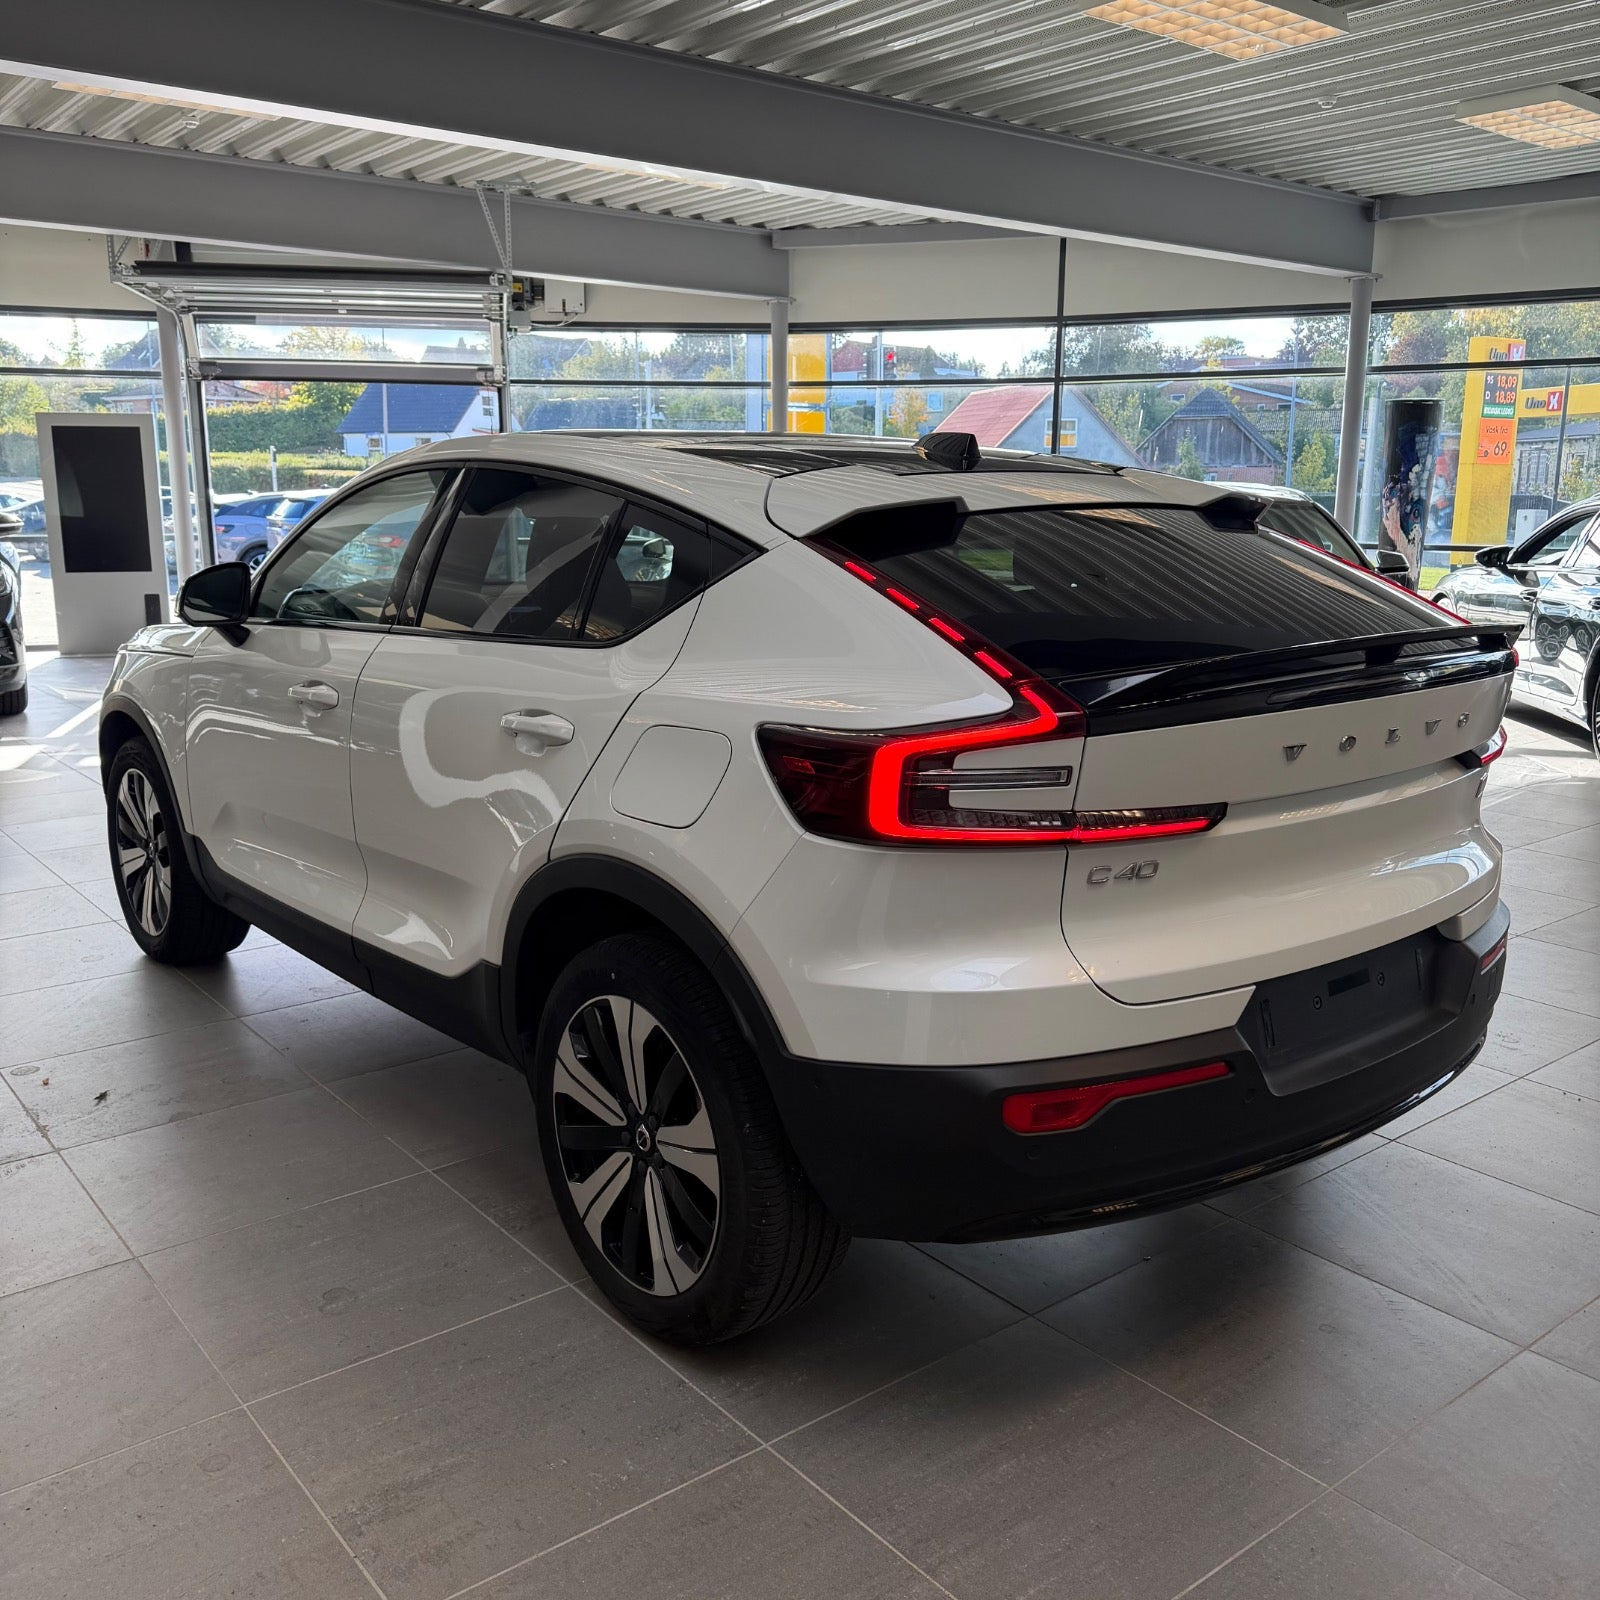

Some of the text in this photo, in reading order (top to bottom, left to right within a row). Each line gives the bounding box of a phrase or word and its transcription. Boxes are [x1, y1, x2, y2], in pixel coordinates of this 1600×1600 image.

[1489, 347, 1508, 361] Uno
[1486, 375, 1517, 389] 95 18,09
[1485, 390, 1516, 404] D 18,89
[1525, 391, 1560, 410] Uno X
[1283, 711, 1470, 761] VOLVO
[1087, 860, 1160, 885] C40
